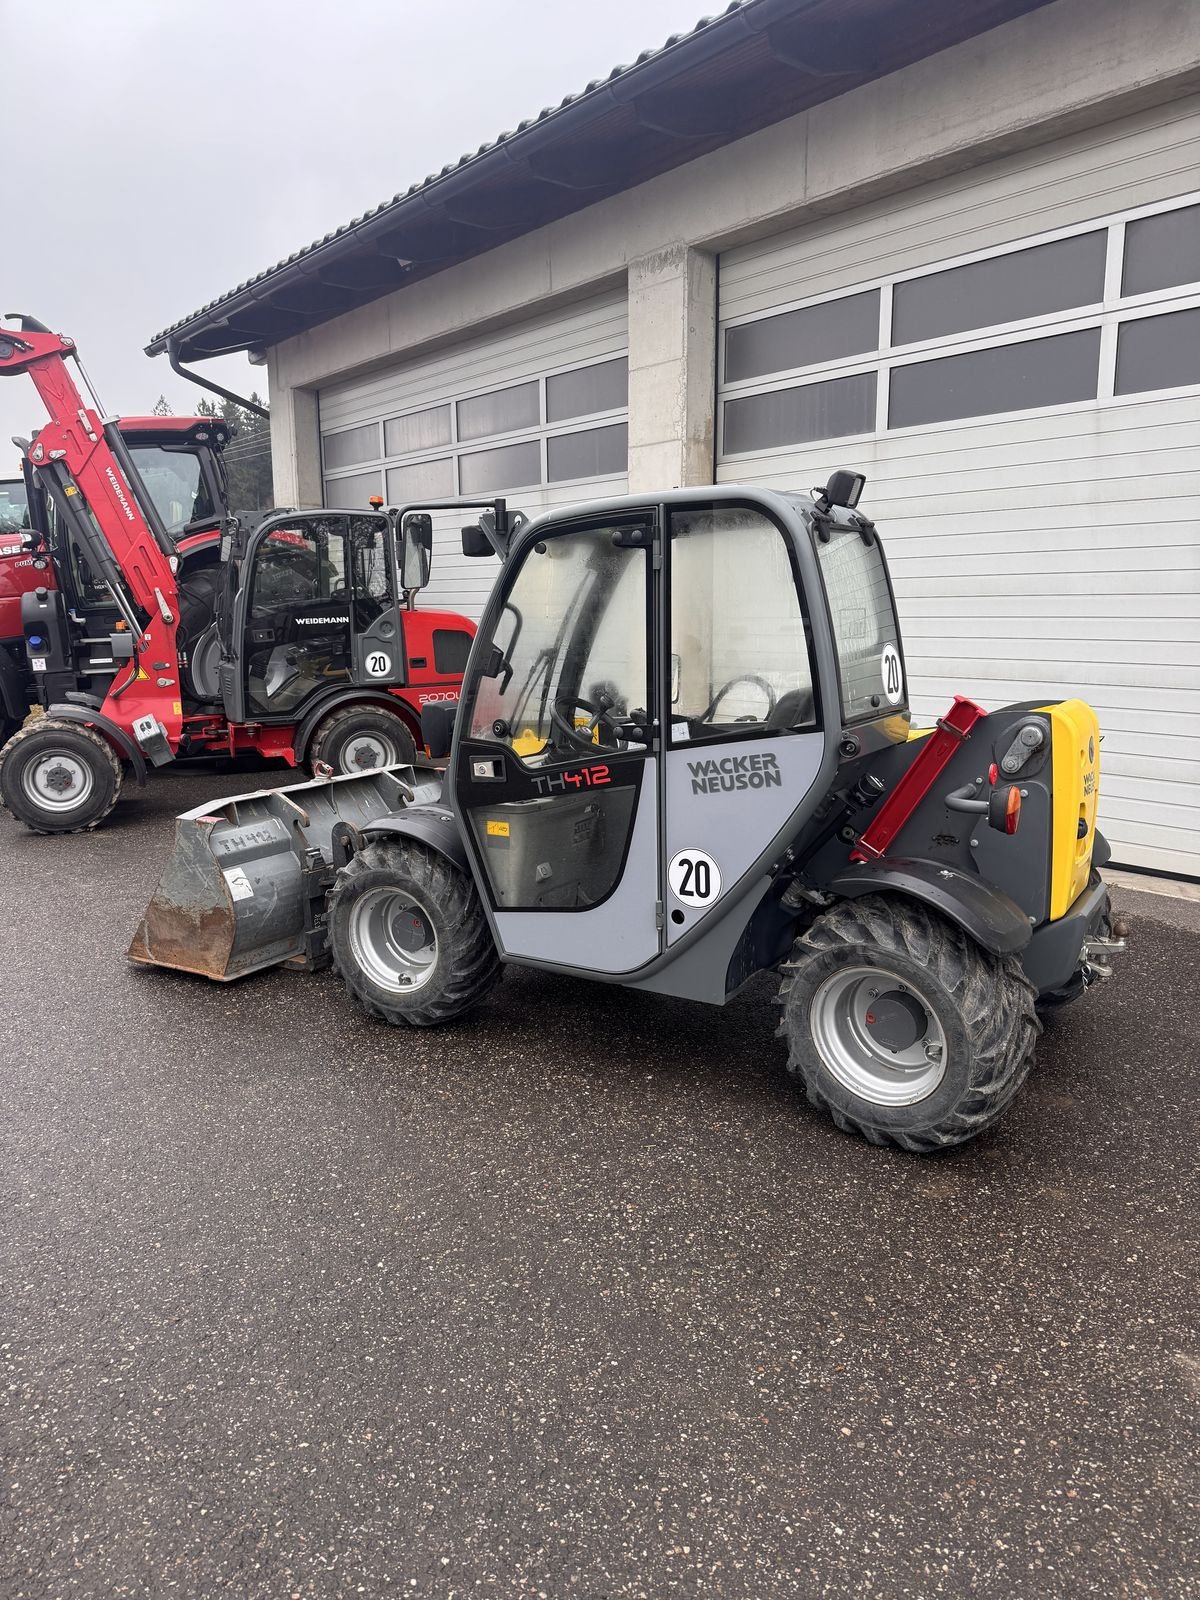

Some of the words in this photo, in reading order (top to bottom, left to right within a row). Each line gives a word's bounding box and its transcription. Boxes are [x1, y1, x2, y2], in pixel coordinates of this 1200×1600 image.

[105, 467, 135, 521] WEIDEMANN
[15, 560, 33, 568] PUM
[295, 616, 349, 625] WEIDEMANN
[370, 656, 386, 673] 20
[884, 654, 900, 695] 20
[687, 752, 780, 779] WACKER
[530, 765, 612, 795] TH412
[690, 769, 782, 796] NEUSON
[678, 858, 711, 899] 20
